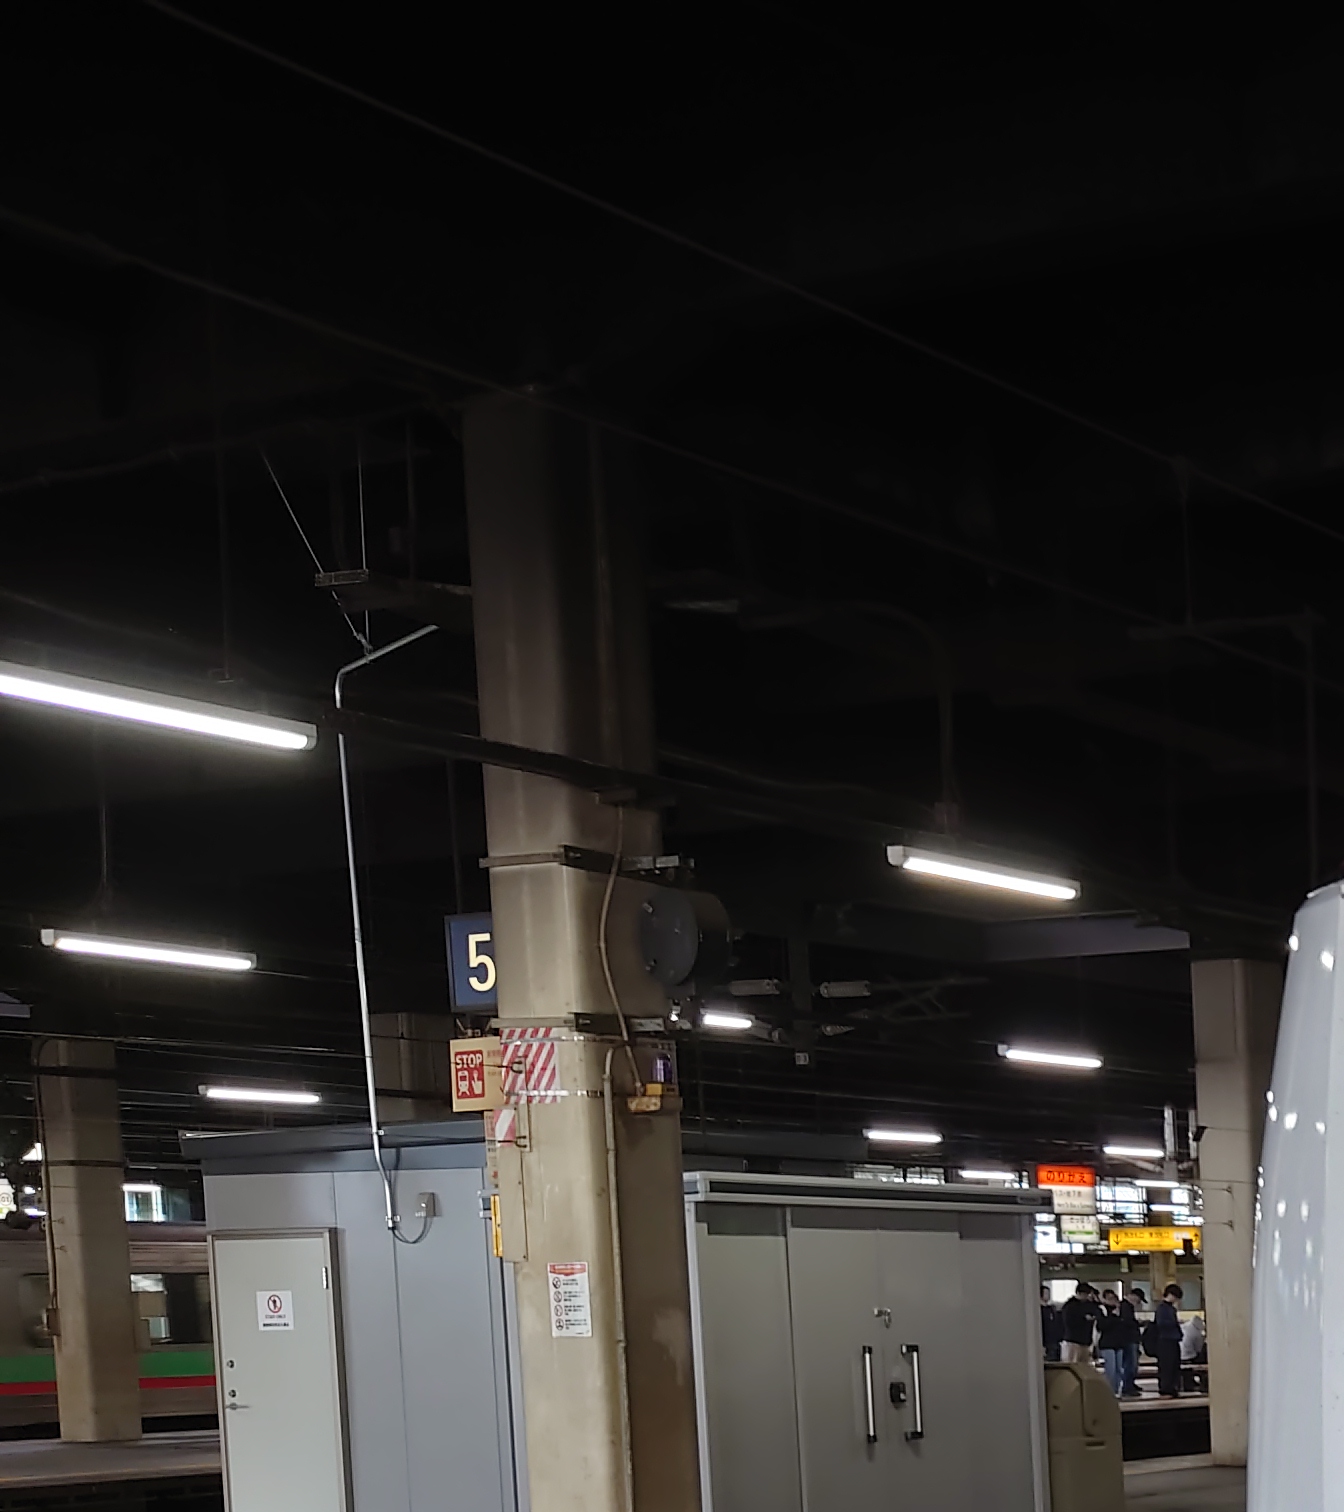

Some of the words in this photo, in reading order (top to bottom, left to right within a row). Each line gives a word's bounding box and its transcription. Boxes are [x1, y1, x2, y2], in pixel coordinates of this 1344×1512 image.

[467, 932, 496, 992] 5
[455, 1053, 483, 1070] STOP
[1046, 1170, 1087, 1184] のりかえ
